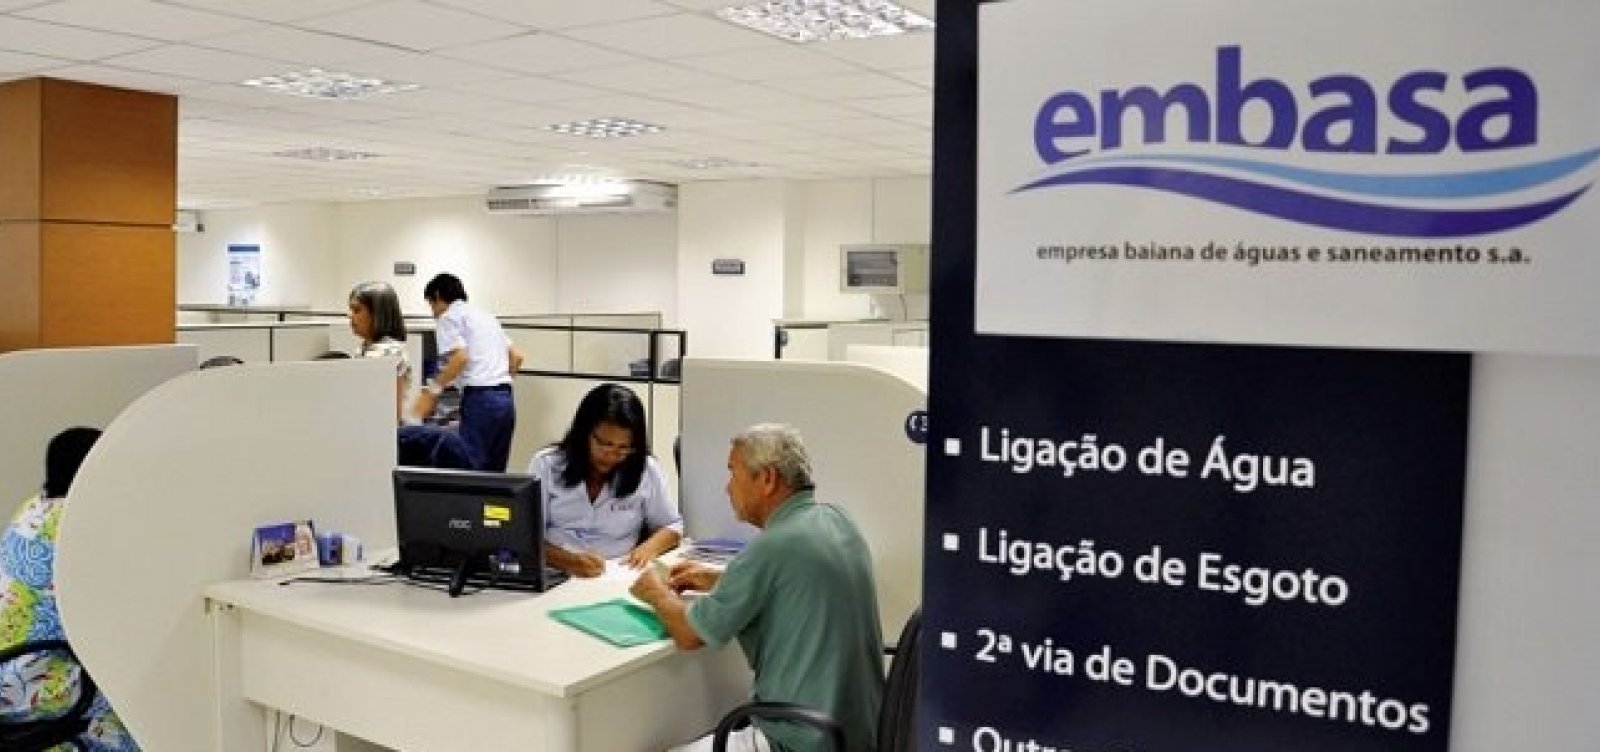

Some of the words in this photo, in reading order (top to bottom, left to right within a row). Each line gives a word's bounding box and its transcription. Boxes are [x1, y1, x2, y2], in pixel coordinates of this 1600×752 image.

[1033, 45, 1538, 165] embasa
[1036, 246, 1120, 263] empresa
[1124, 242, 1195, 261] baiana
[1200, 243, 1228, 261] de
[1232, 242, 1301, 264] águas
[1306, 247, 1322, 263] e
[1326, 246, 1482, 263] saneamento
[1486, 247, 1531, 263] s.a.
[980, 427, 1127, 477] Ligação
[1137, 437, 1190, 477] de
[1200, 435, 1315, 492] Água
[978, 527, 1124, 581] Ligação
[1133, 545, 1187, 586] de
[1197, 552, 1349, 606] Esgoto
[975, 629, 1013, 663] 2ª
[1021, 637, 1075, 676] via
[1085, 644, 1135, 686] de
[1145, 654, 1430, 733] Documentos
